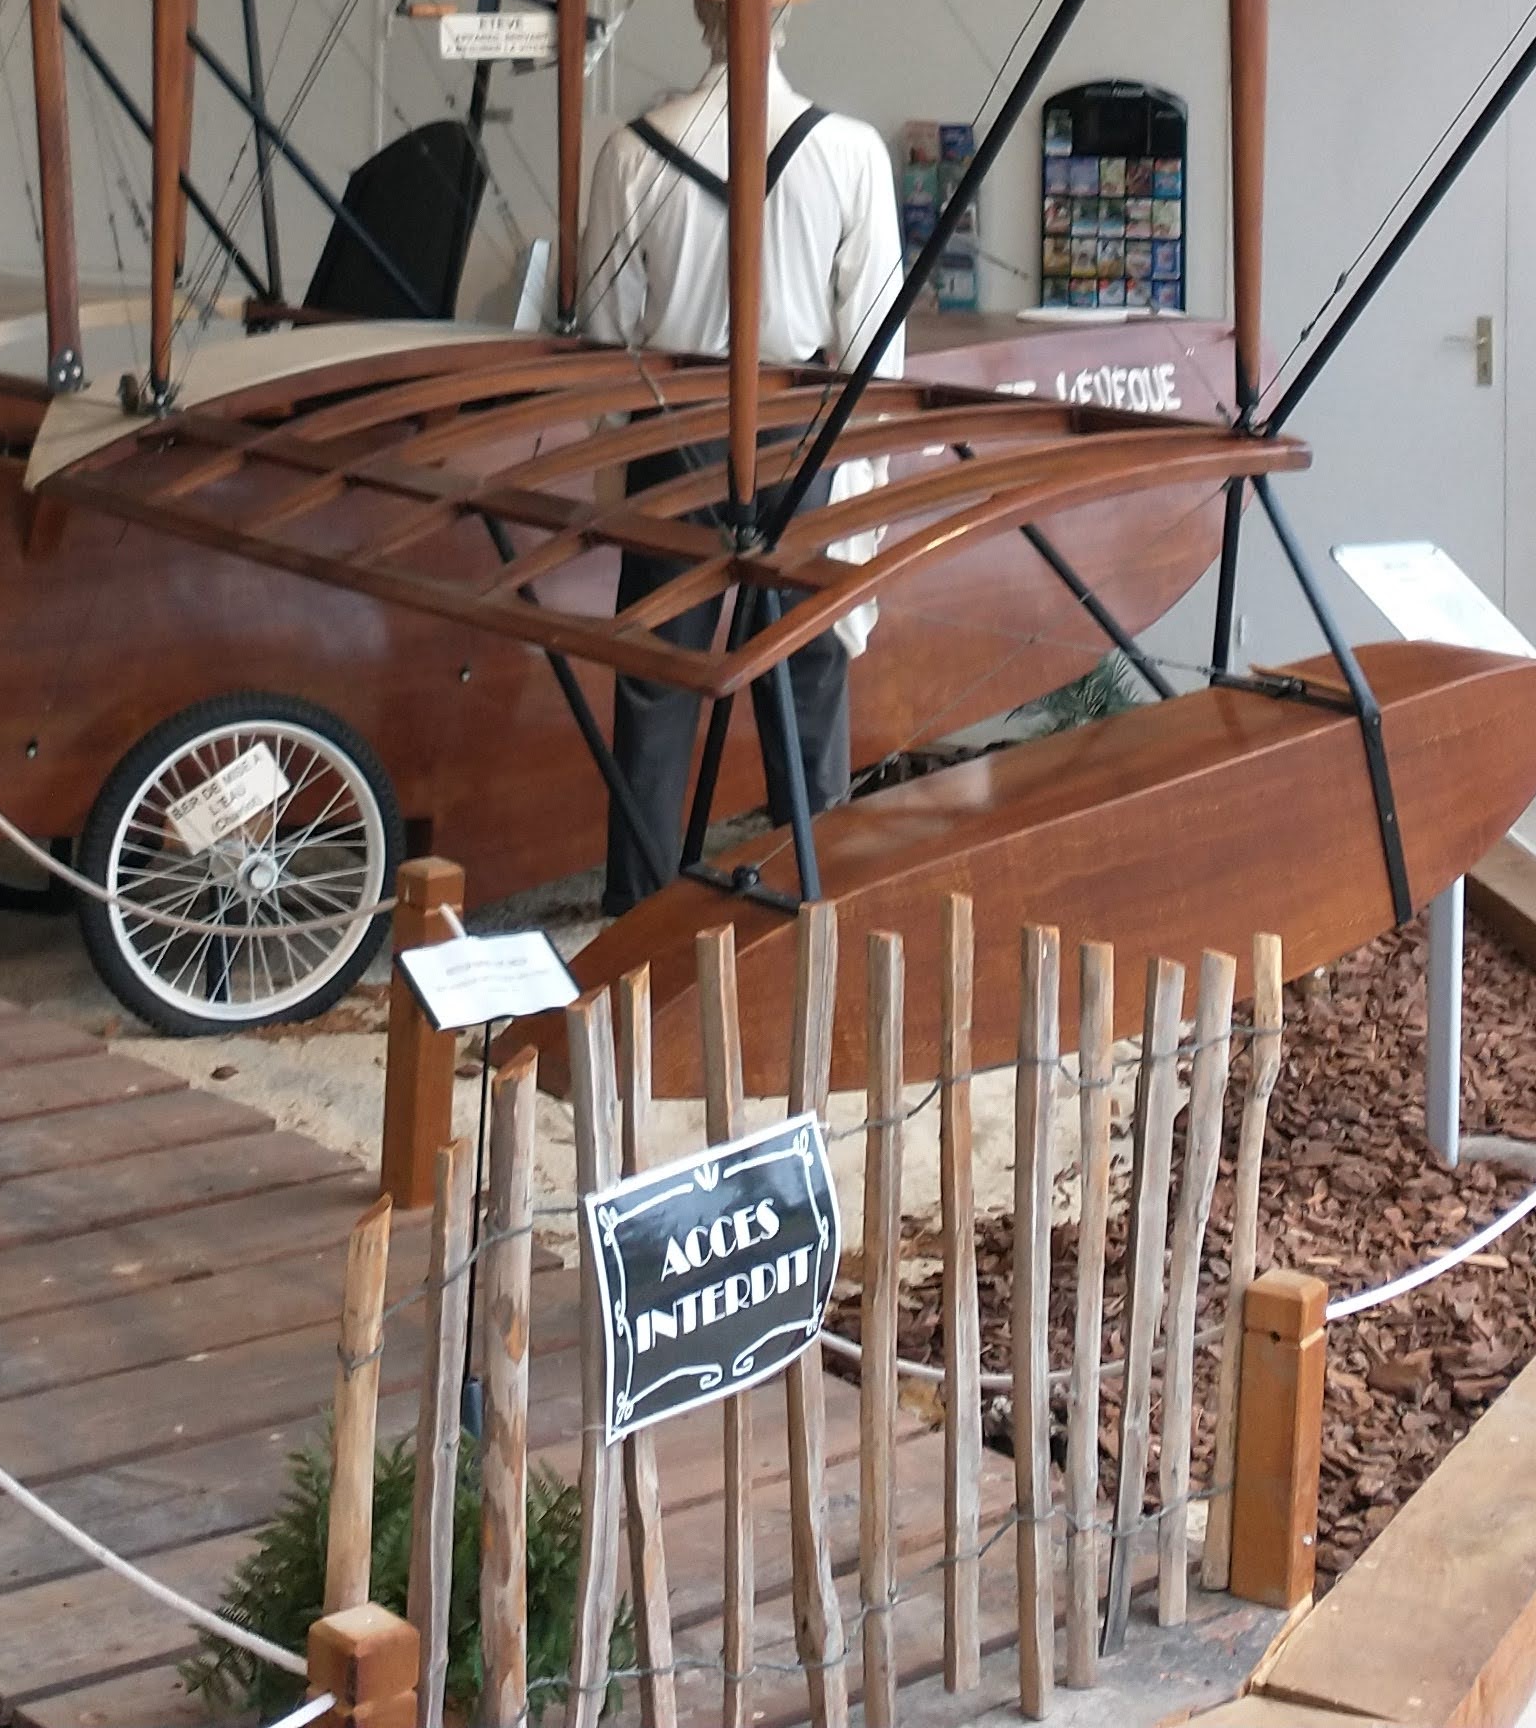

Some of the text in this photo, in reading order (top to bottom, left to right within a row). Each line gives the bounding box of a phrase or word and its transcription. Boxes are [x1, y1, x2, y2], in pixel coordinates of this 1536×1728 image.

[201, 781, 220, 801] DE
[660, 1196, 780, 1282] ACCES
[636, 1244, 814, 1354] INTERDIT
